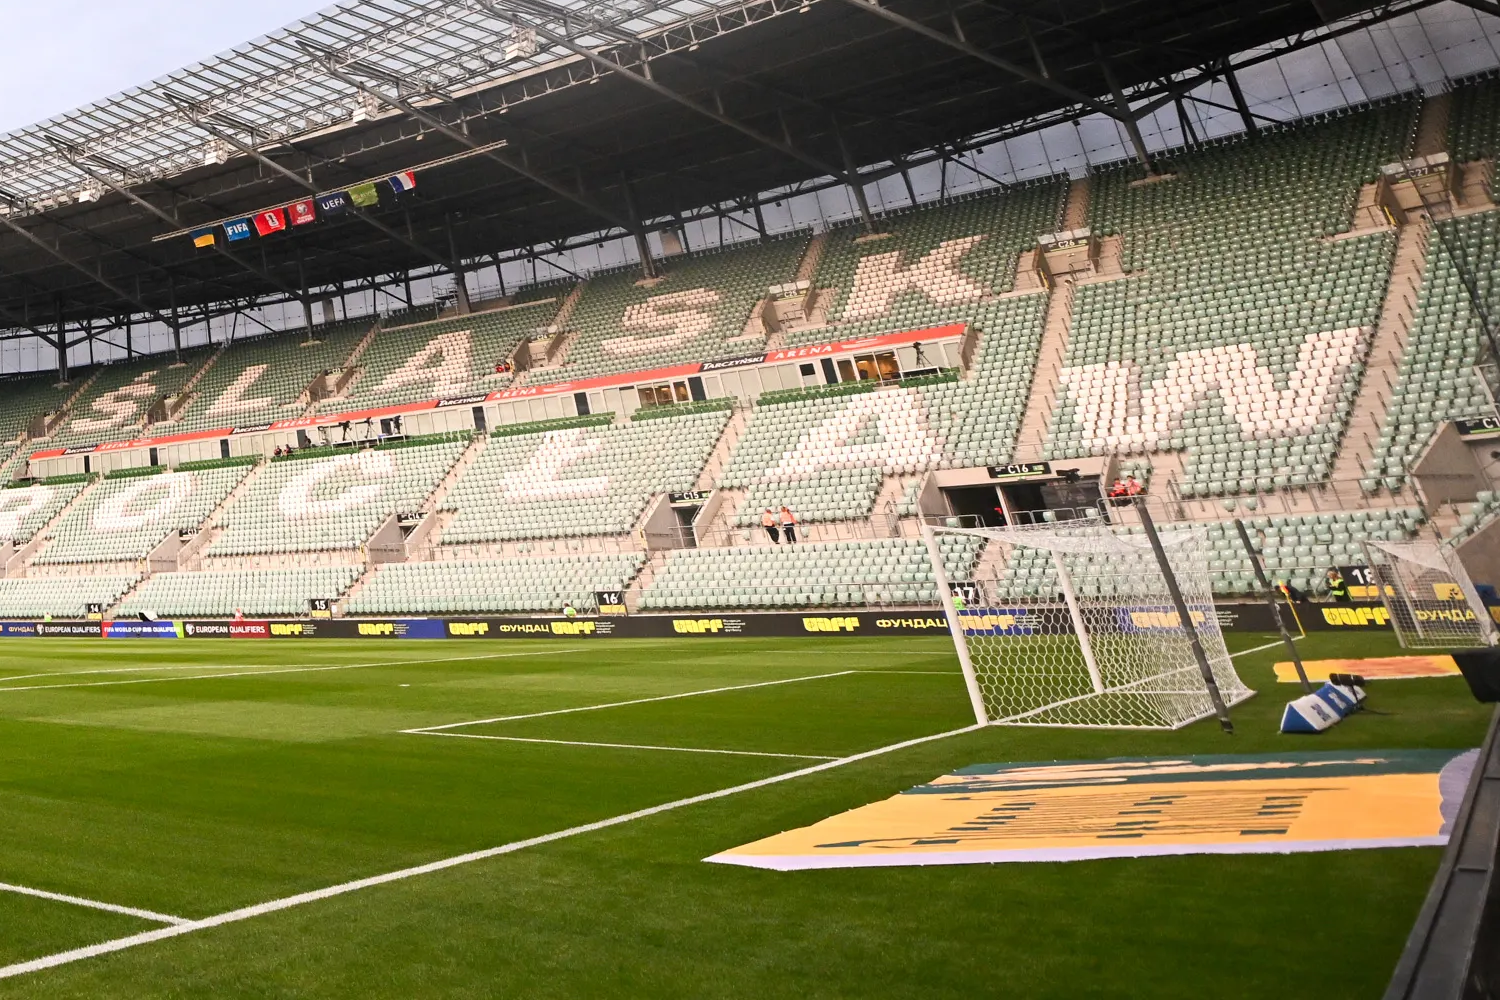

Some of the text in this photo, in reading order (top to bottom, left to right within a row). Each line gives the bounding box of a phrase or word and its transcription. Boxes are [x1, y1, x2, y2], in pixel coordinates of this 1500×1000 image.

[1409, 167, 1428, 178] C27
[322, 198, 345, 210] UEFA
[227, 223, 248, 235] FIFA
[1058, 240, 1075, 248] C26
[702, 345, 833, 370] TARCZYŃSKI ARENA
[493, 388, 537, 399] ARENA
[275, 418, 311, 429] ARENA
[100, 441, 130, 450] ARENA
[1007, 463, 1029, 475] C16
[683, 491, 699, 500] C15
[603, 593, 618, 604] 16
[953, 587, 974, 600] 17
[90, 604, 99, 613] 14
[315, 601, 326, 610] 15
[500, 624, 550, 633] ФУНДАЦ
[876, 618, 948, 628] ФУНДАЦ
